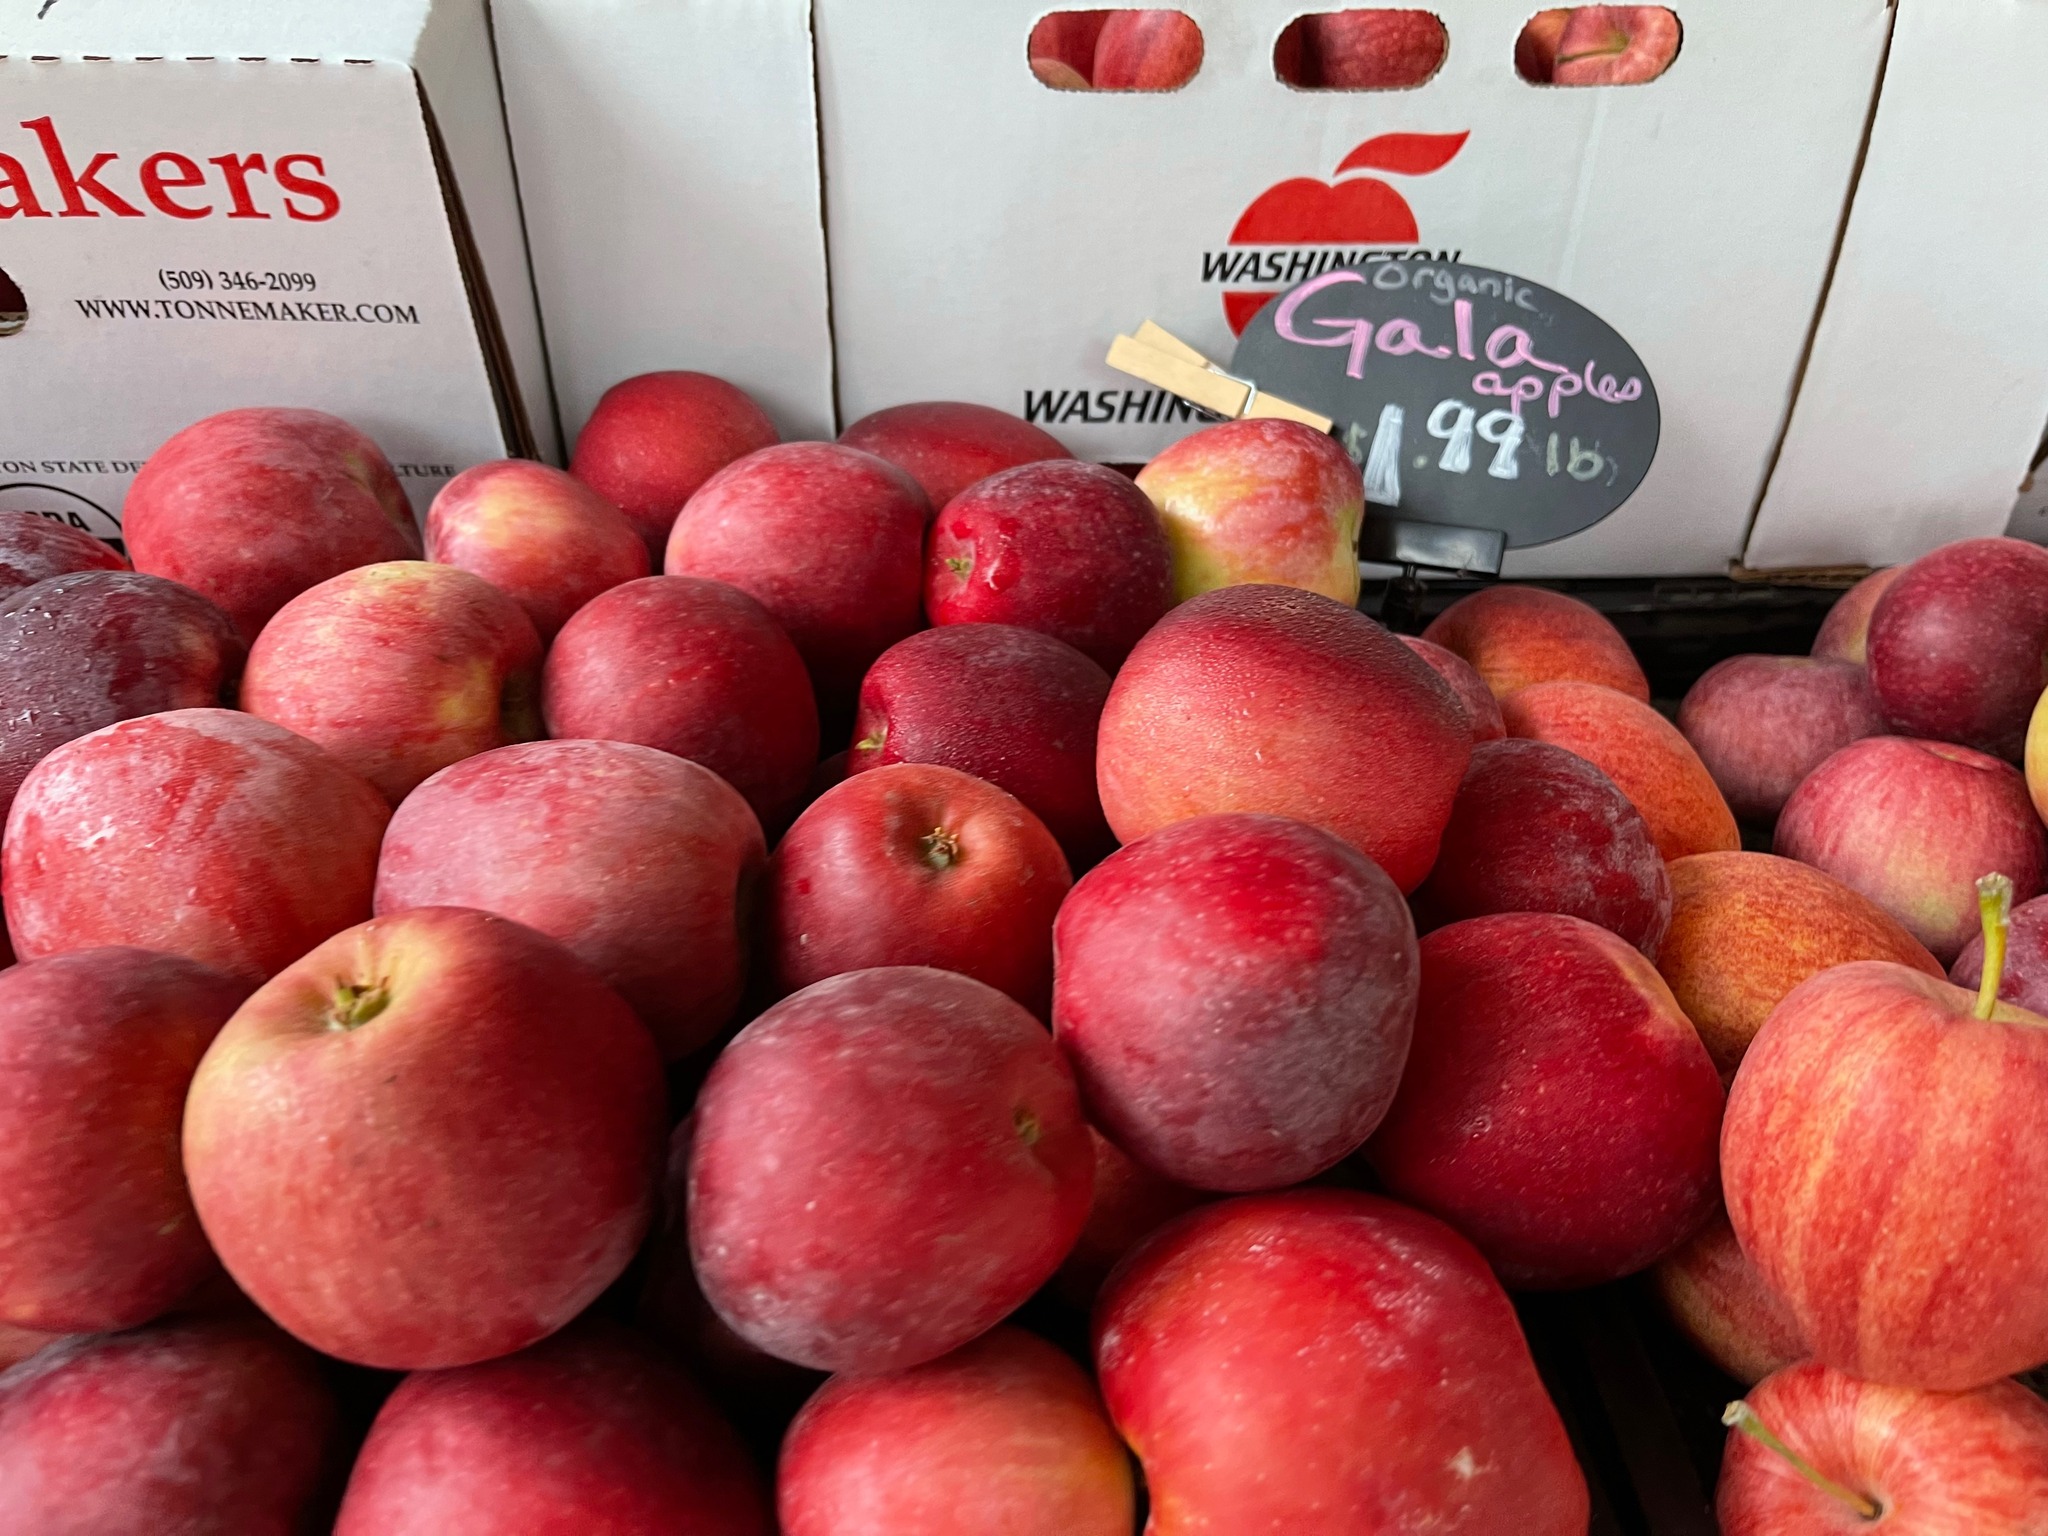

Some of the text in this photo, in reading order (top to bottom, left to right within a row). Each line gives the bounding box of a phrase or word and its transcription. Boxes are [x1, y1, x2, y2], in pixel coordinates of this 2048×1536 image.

[0, 116, 340, 222] akers
[159, 269, 316, 292] (509) 346-2099
[1201, 249, 1462, 282] WASHIN
[1372, 262, 1540, 313] Organic
[75, 299, 420, 324] WWW.TONNEMAKER.COM
[1274, 270, 1570, 379] Gala
[1472, 360, 1642, 418] apples
[1024, 390, 1226, 424] WASHIN
[0, 460, 38, 474] ON
[41, 460, 109, 474] STATE
[394, 463, 456, 478] TURE
